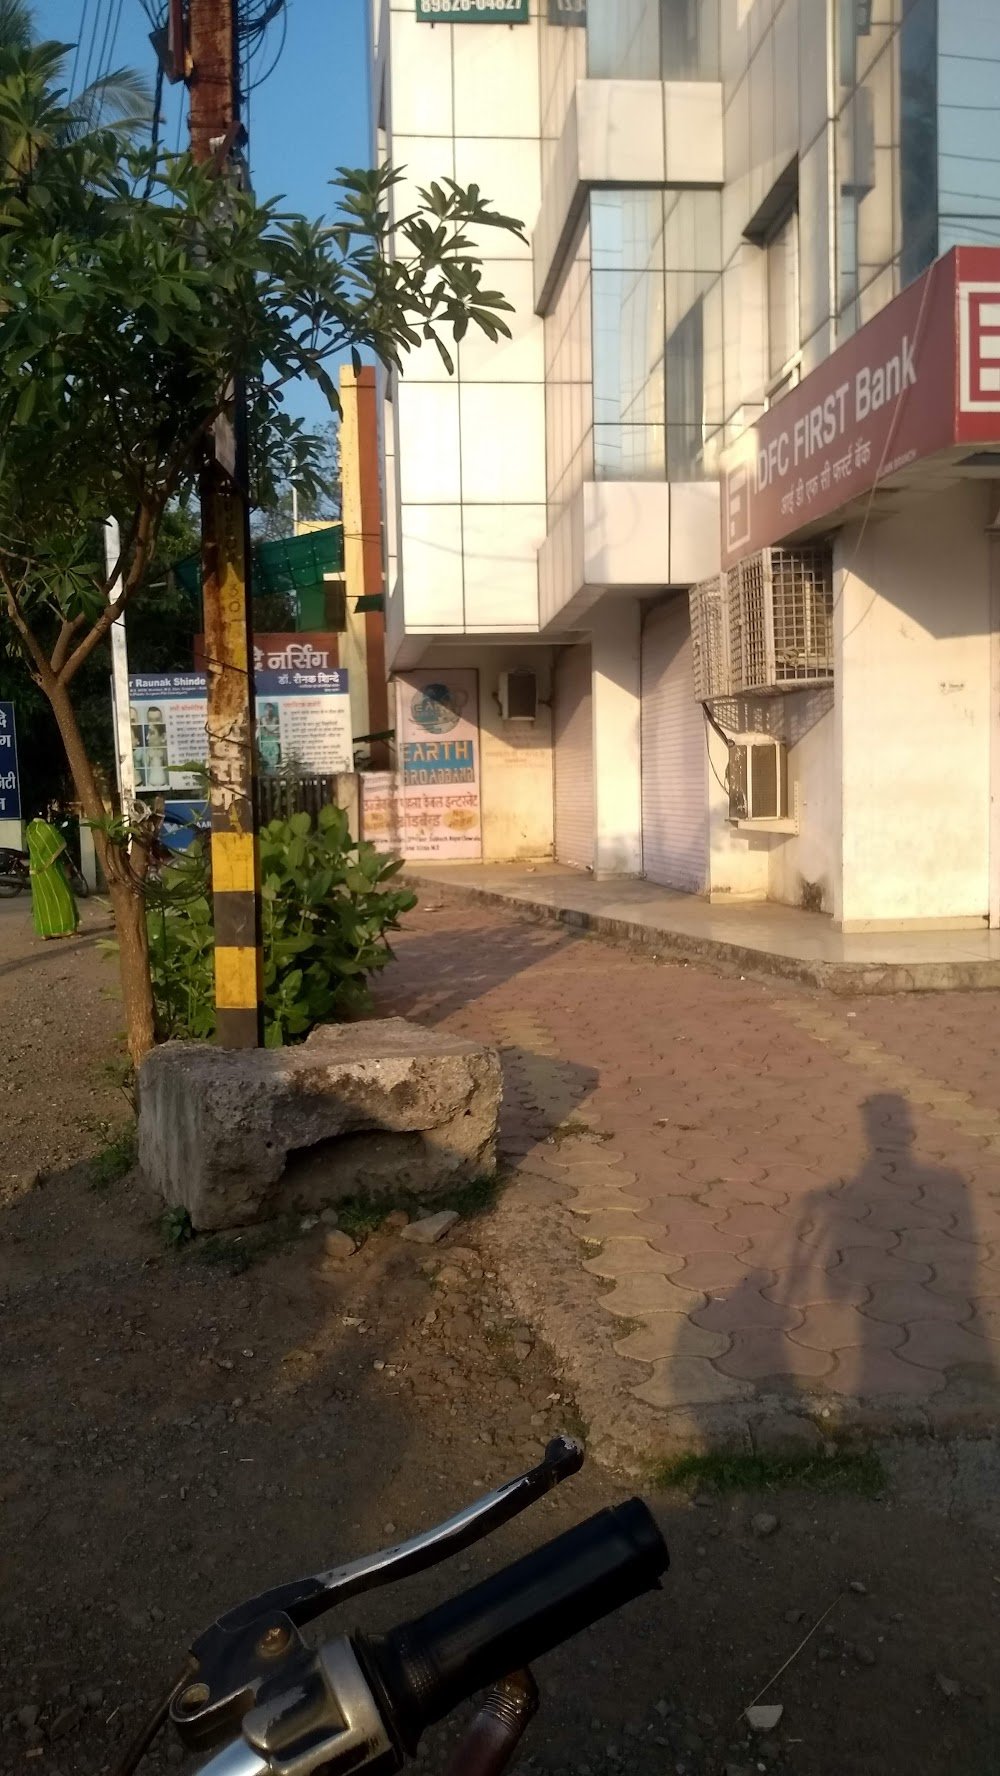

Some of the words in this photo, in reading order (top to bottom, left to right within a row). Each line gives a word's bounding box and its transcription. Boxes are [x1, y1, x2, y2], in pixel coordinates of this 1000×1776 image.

[793, 382, 850, 467] FIRST
[855, 335, 917, 423] Bank
[267, 643, 329, 670] नर्सिंग
[136, 678, 171, 687] Raunak
[174, 677, 206, 686] Shinde
[402, 741, 469, 762] EARTH
